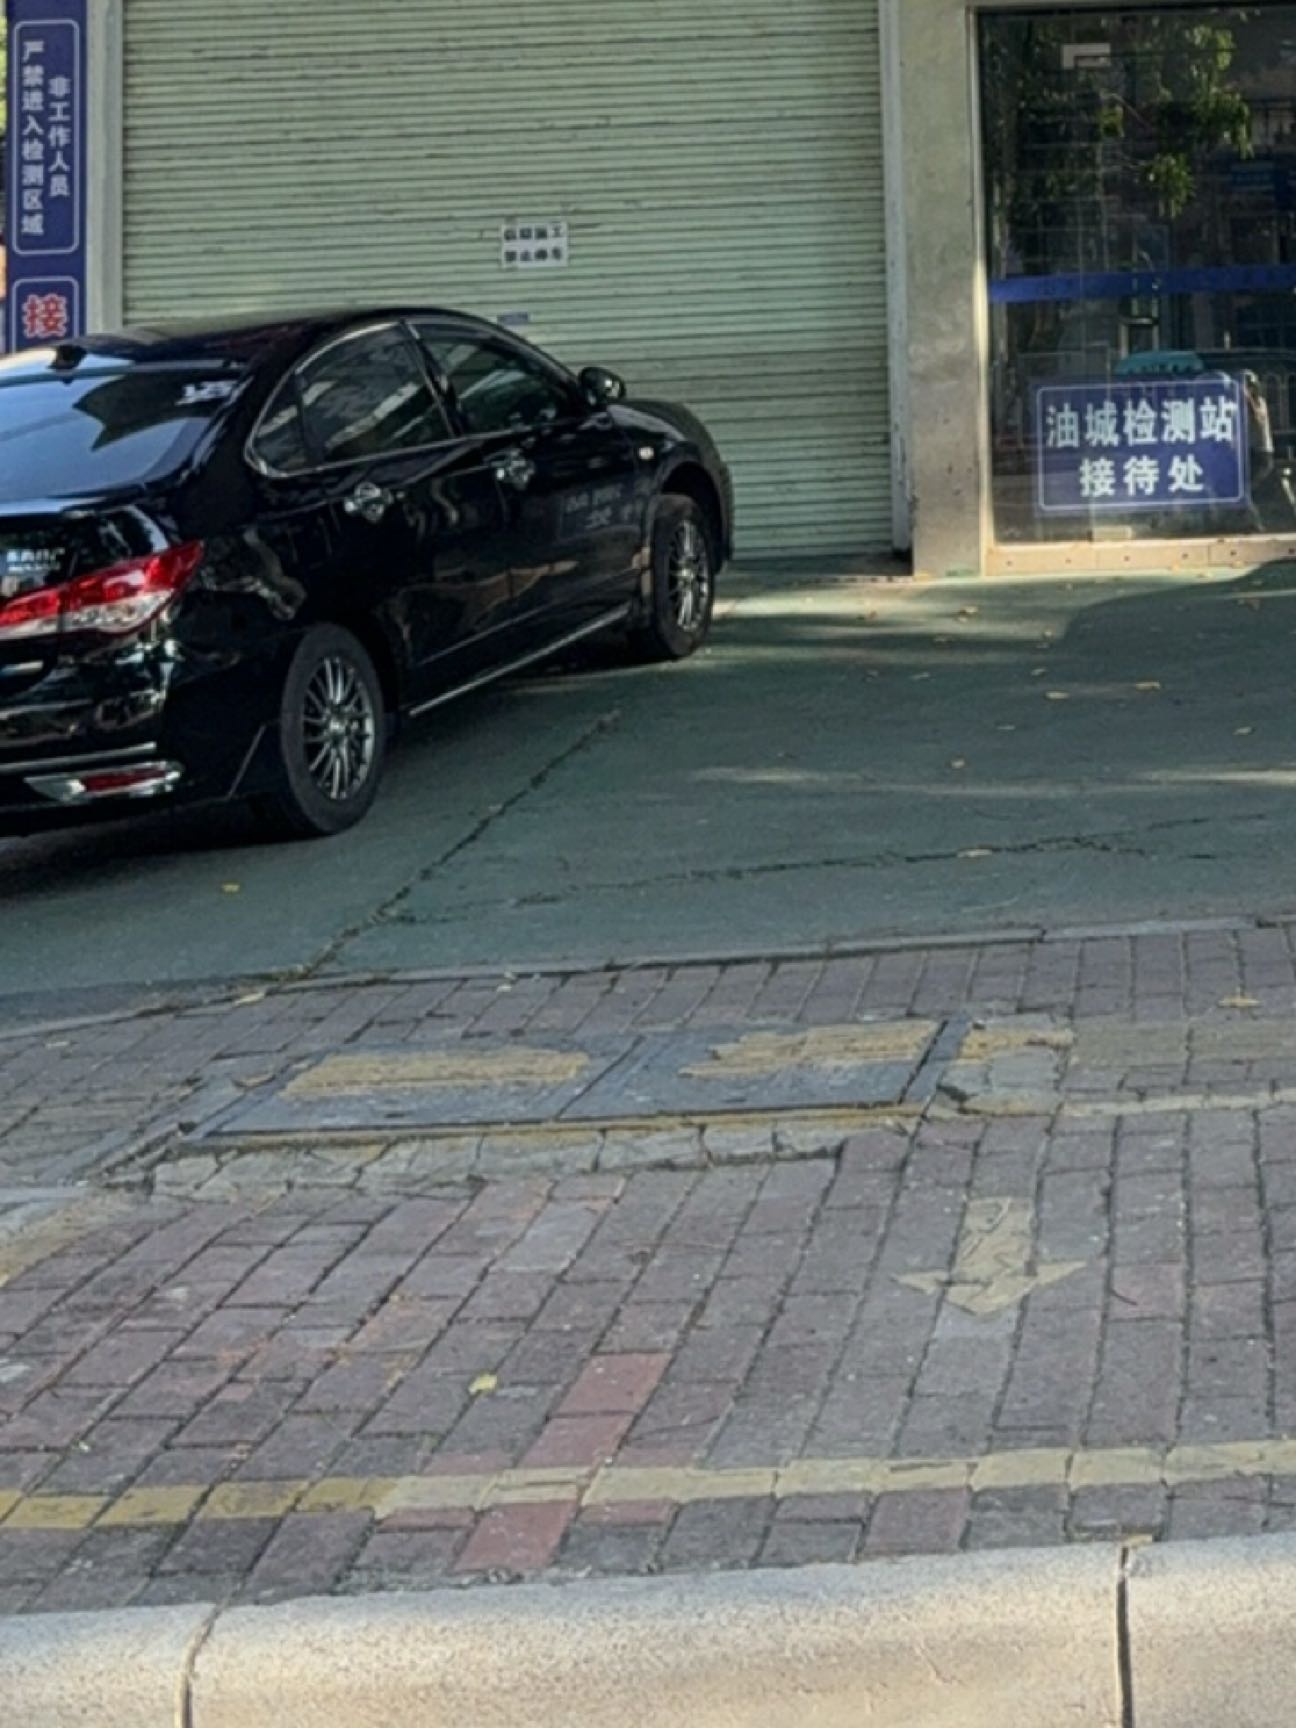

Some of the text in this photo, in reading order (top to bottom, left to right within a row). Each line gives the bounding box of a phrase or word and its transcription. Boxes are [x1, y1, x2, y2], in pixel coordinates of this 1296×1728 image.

[21, 39, 45, 236] 严禁进入检测区域
[47, 76, 71, 197] 非工作人员
[22, 294, 67, 338] 接
[1045, 396, 1237, 448] 油城检测站
[1079, 453, 1204, 498] 接待处
